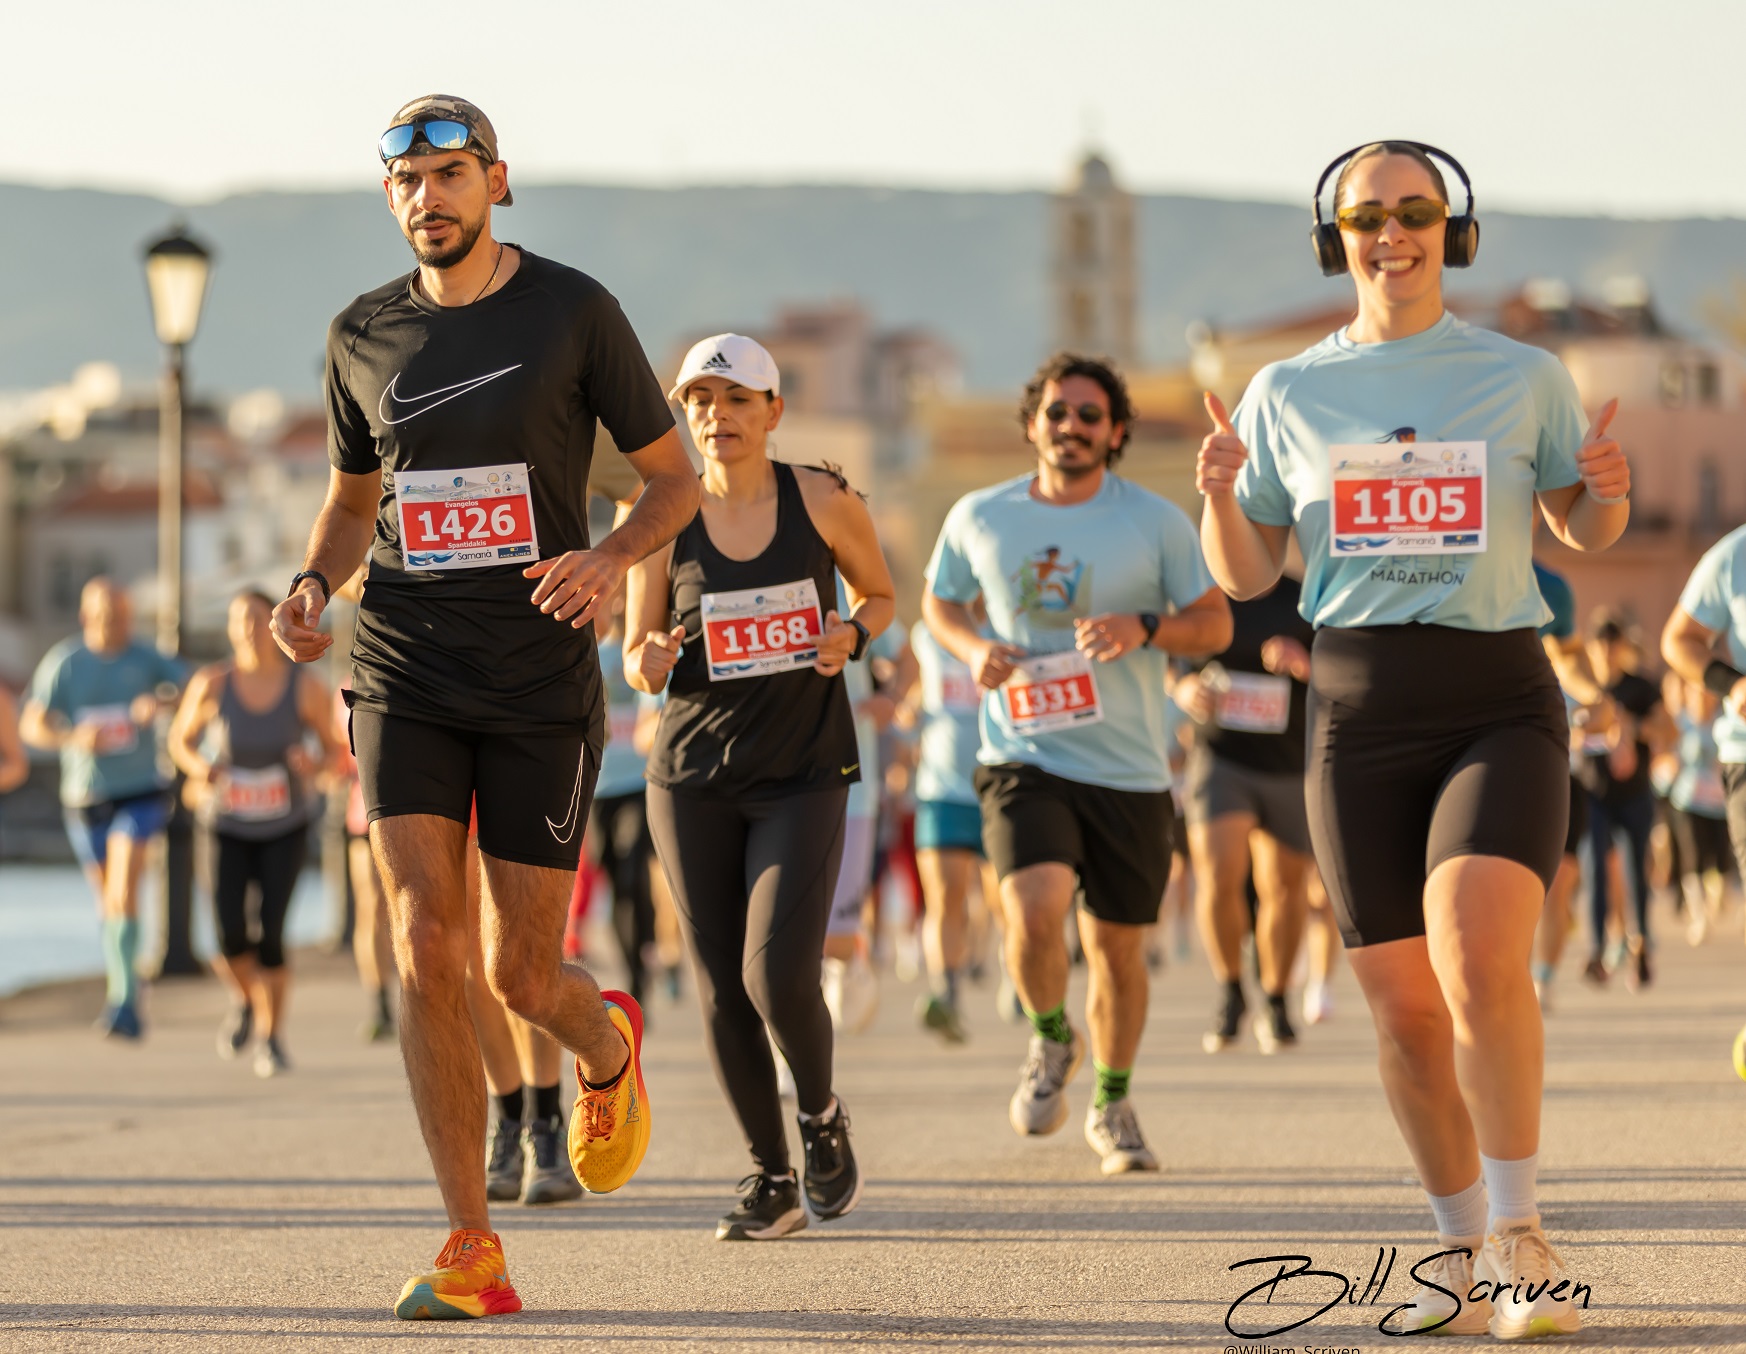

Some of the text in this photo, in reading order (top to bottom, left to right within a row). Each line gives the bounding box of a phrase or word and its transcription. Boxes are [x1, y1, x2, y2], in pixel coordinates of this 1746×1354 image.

[445, 500, 479, 509] Evangelos
[1353, 486, 1467, 524] 1105
[418, 504, 516, 542] 1426
[447, 540, 487, 549] Spantidakis
[1370, 569, 1465, 586] MARATHON
[722, 616, 808, 655] 1168
[1014, 680, 1086, 716] 1331
